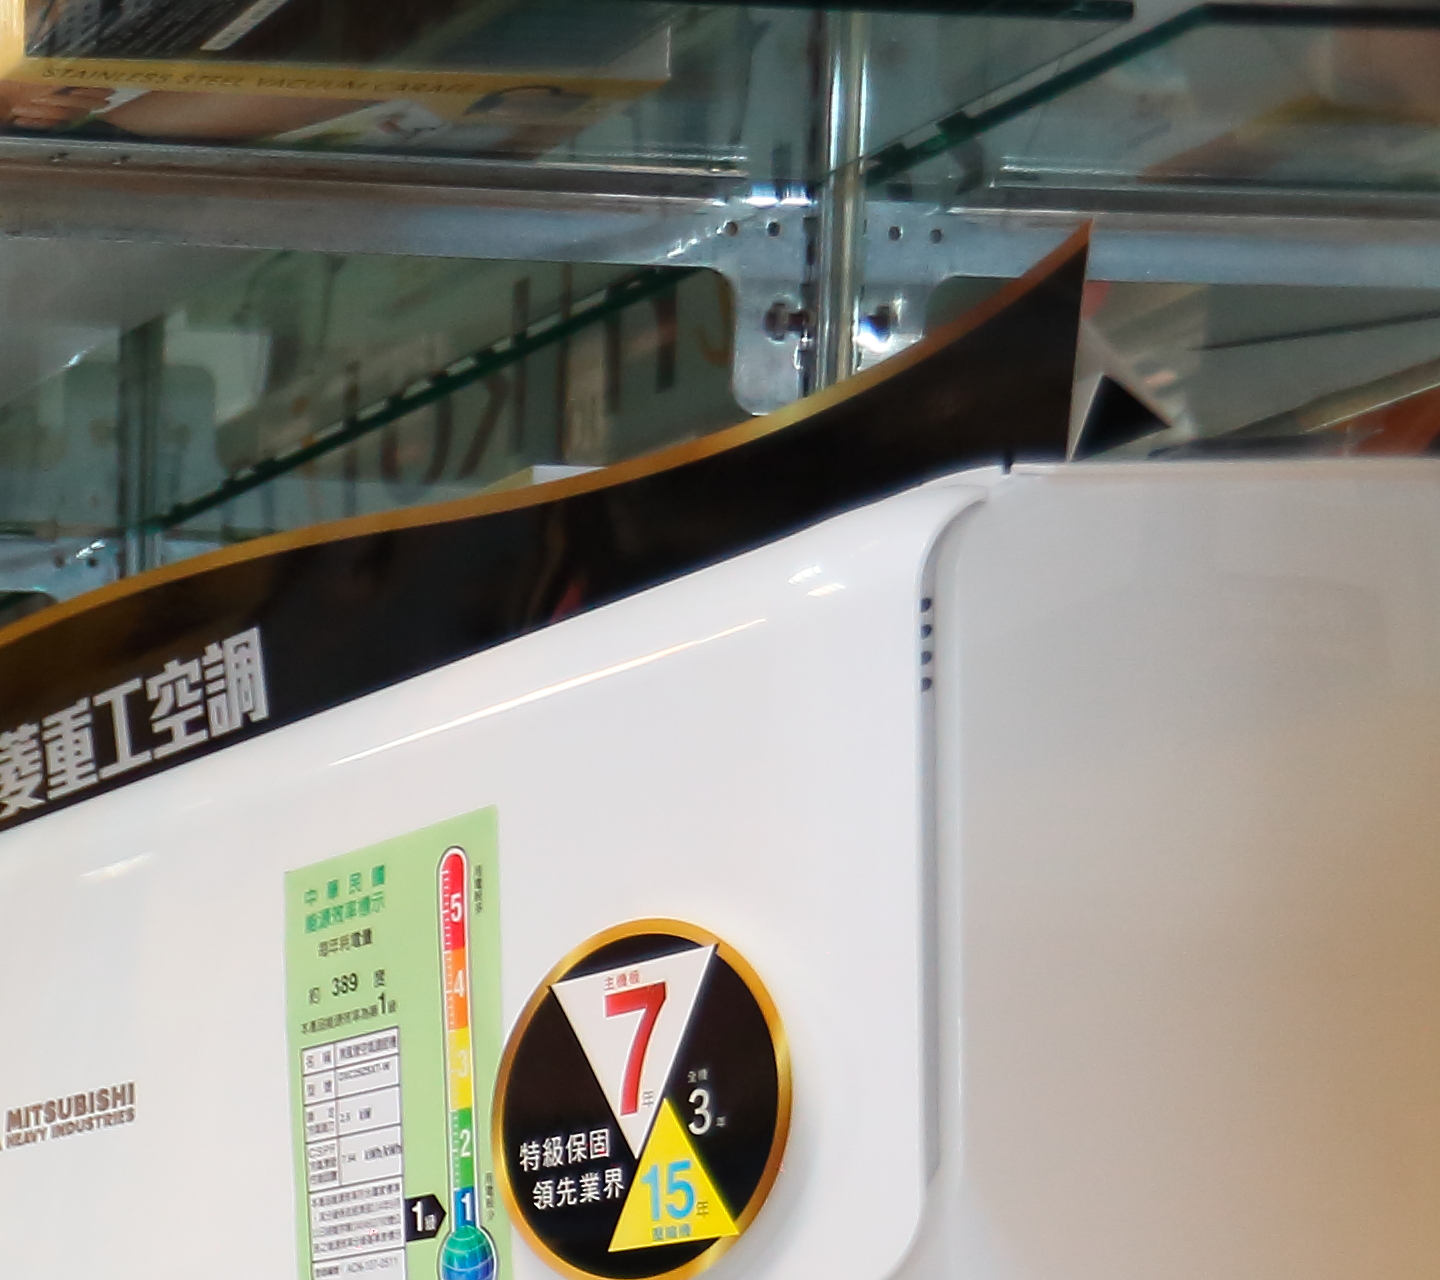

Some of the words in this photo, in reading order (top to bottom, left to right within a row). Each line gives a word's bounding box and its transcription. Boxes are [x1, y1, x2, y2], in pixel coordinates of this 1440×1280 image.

[450, 892, 462, 923] 5
[453, 970, 465, 998] 4
[603, 980, 668, 1117] 7
[5, 1081, 136, 1132] MITSUBISHI
[5, 1126, 48, 1149] HEAVY
[51, 1107, 135, 1139] INDUSTRIES
[687, 1086, 713, 1136] 3
[459, 1129, 471, 1158] 2
[519, 1127, 612, 1173] 特級保固
[460, 1192, 473, 1222] 1
[532, 1167, 626, 1212] 領先業界
[641, 1159, 696, 1222] 15
